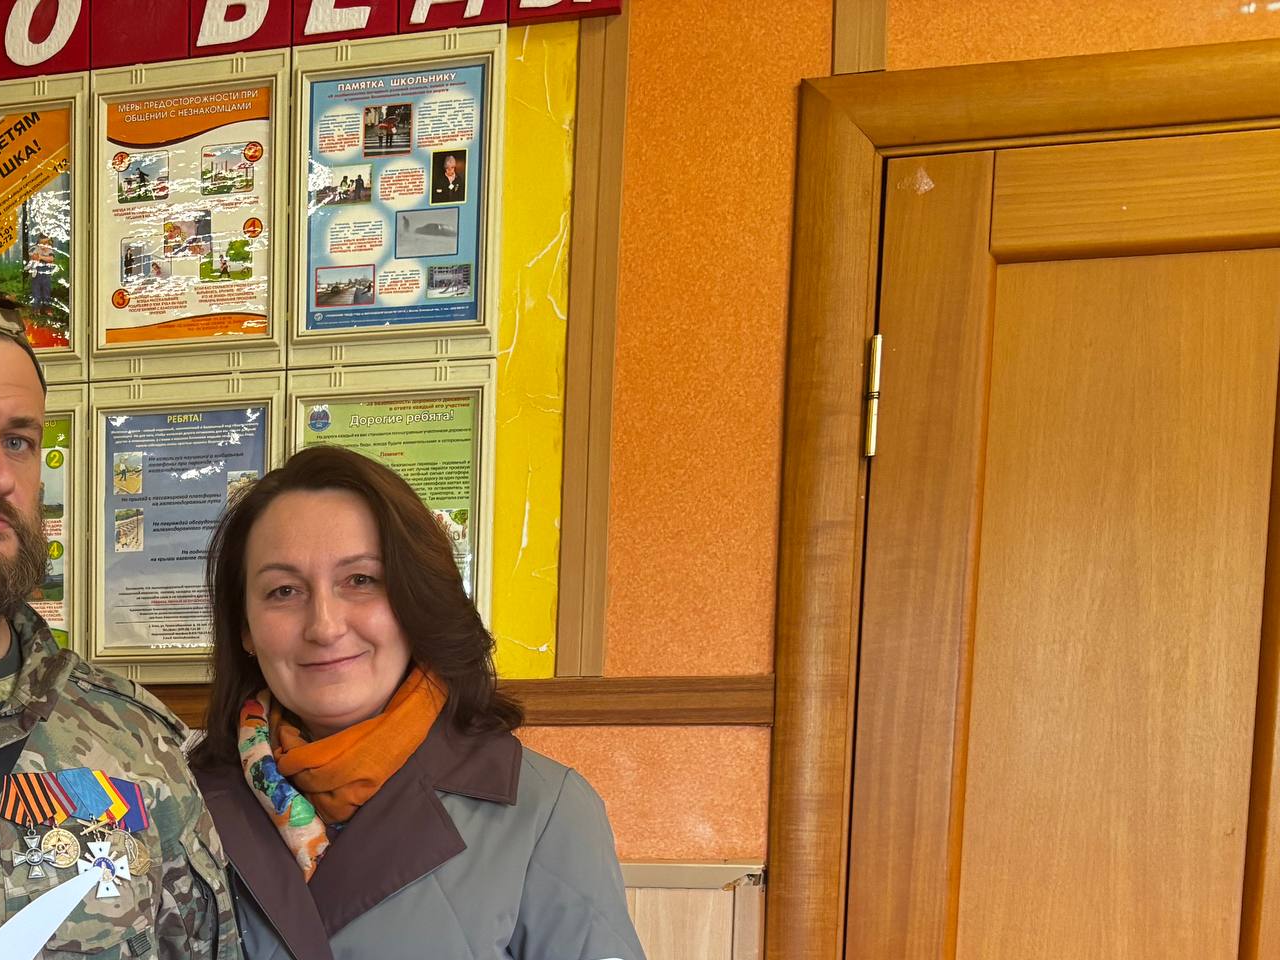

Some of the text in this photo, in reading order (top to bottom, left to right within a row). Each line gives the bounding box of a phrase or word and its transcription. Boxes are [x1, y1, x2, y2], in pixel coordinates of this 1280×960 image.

[337, 78, 384, 91] ПАМЯТКА
[390, 72, 456, 87] ШКОЛЬНИКУ
[118, 89, 259, 112] МЕРЫ ПРЕДОСТОРОЖНОСТИ ПРИ
[124, 102, 252, 123] ОБЩЕНИИ С НЕЗНАКОМЦАМИ
[167, 413, 202, 424] РЕБЯТА!
[349, 410, 455, 428] Дорогие ребята!
[50, 451, 60, 467] 2
[48, 542, 59, 558] 4
